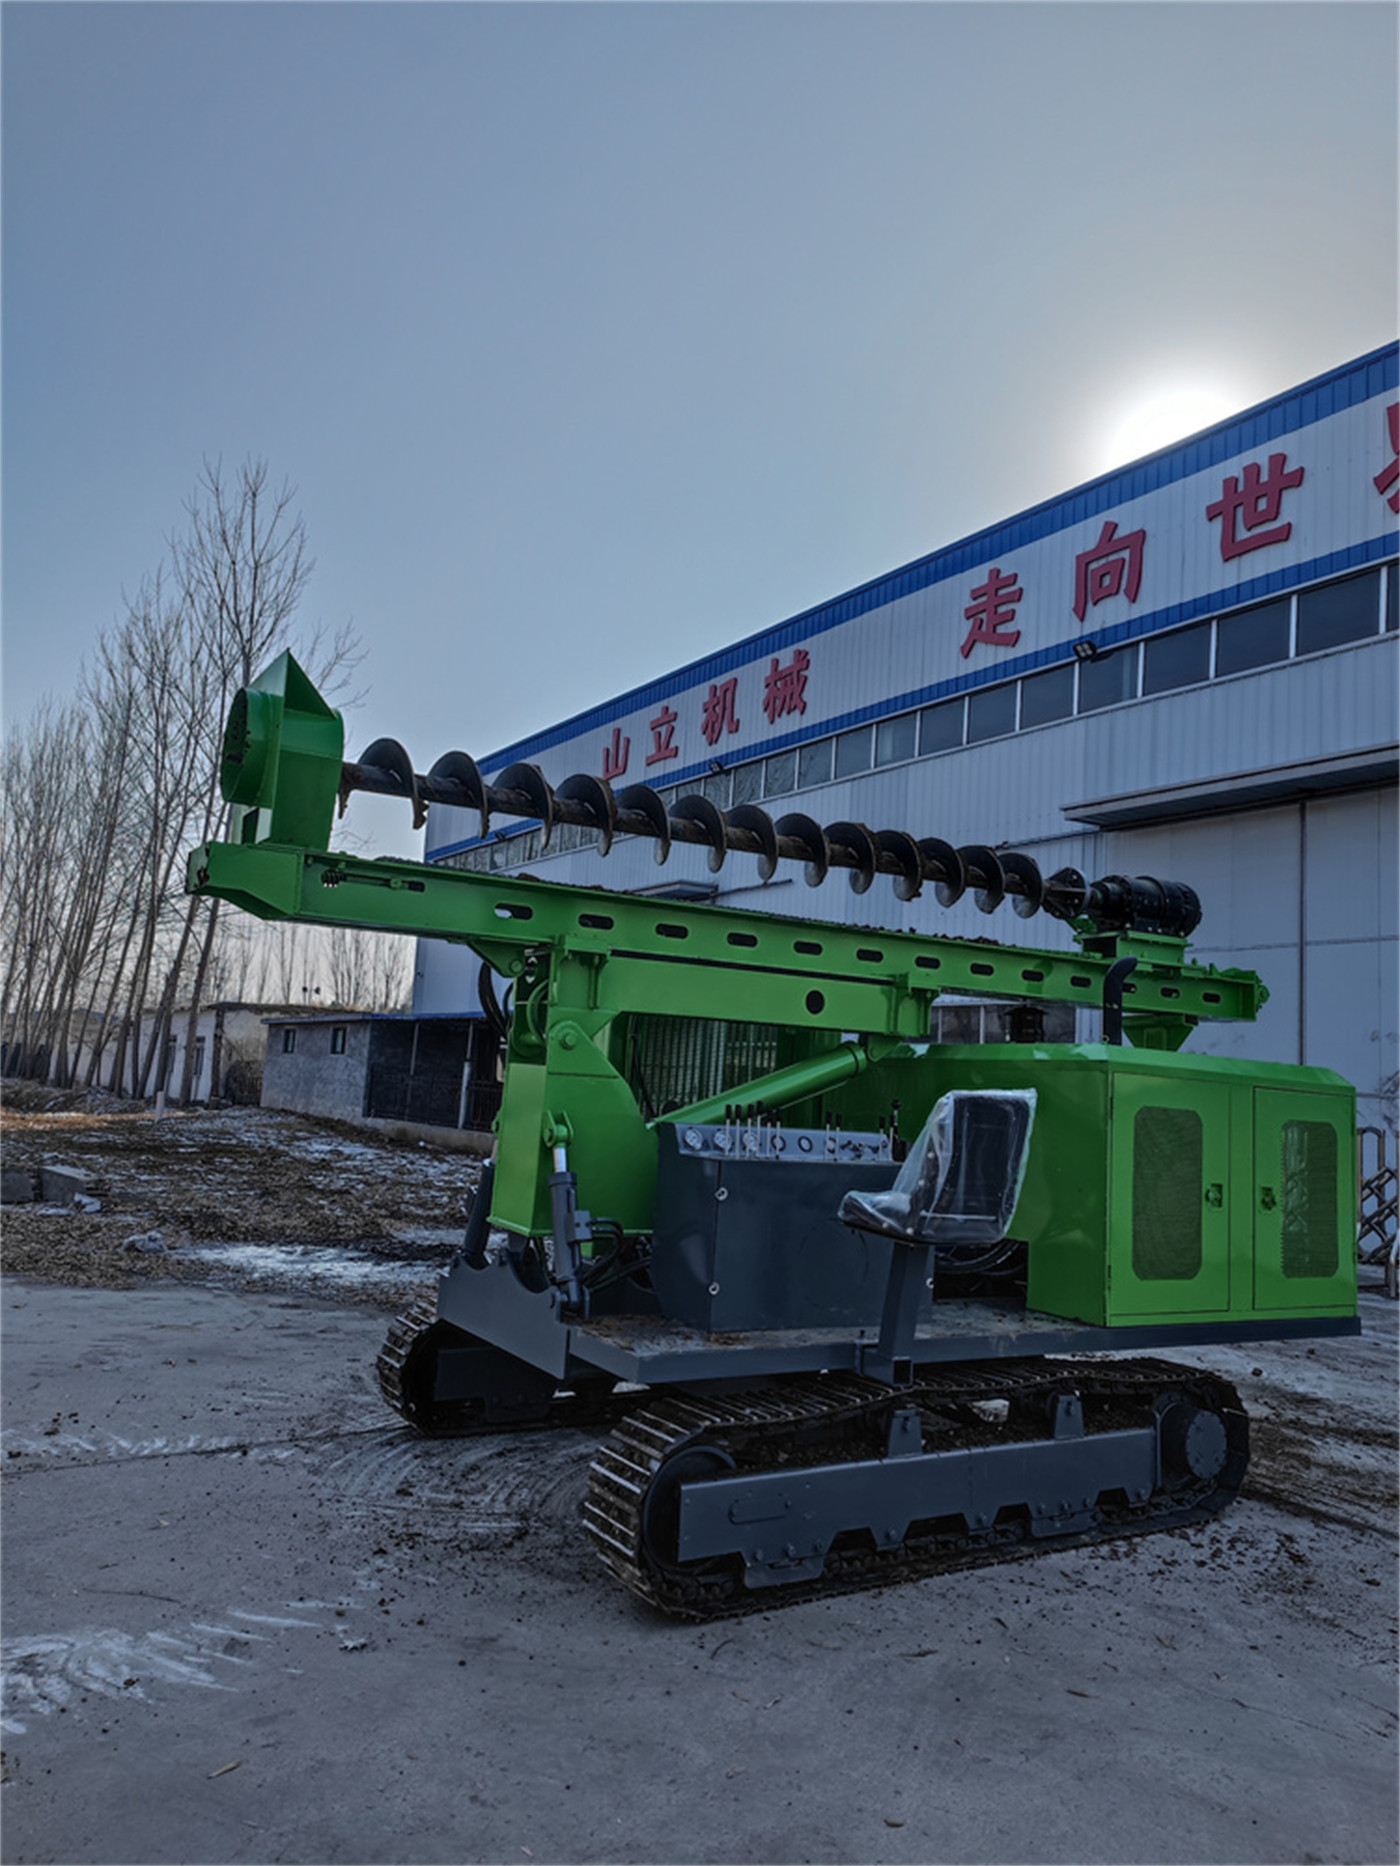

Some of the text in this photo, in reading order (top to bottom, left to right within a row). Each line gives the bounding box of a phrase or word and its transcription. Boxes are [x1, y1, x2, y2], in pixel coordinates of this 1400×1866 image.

[602, 402, 1400, 780] 山立机械 走向世
